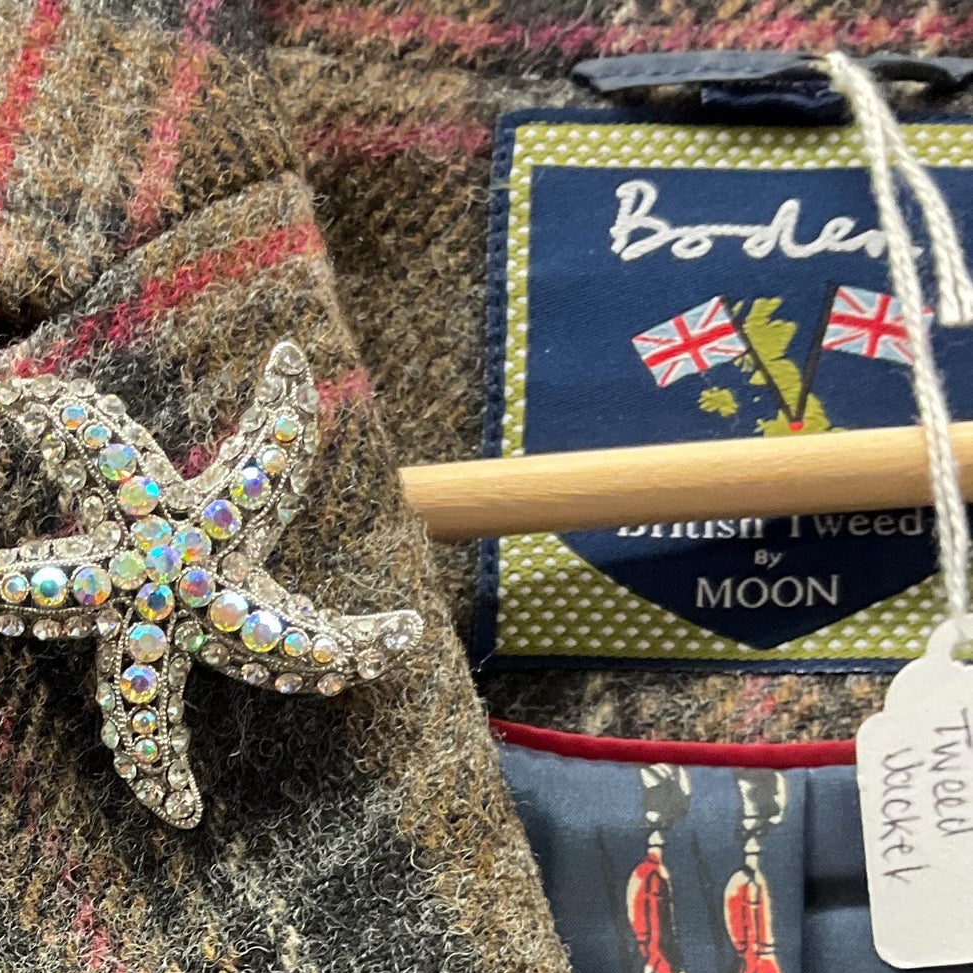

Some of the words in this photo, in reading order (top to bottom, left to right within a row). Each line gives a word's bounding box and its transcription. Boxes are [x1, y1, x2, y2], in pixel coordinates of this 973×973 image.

[754, 549, 783, 569] By
[696, 574, 839, 609] MOON
[929, 708, 973, 837] Tweed
